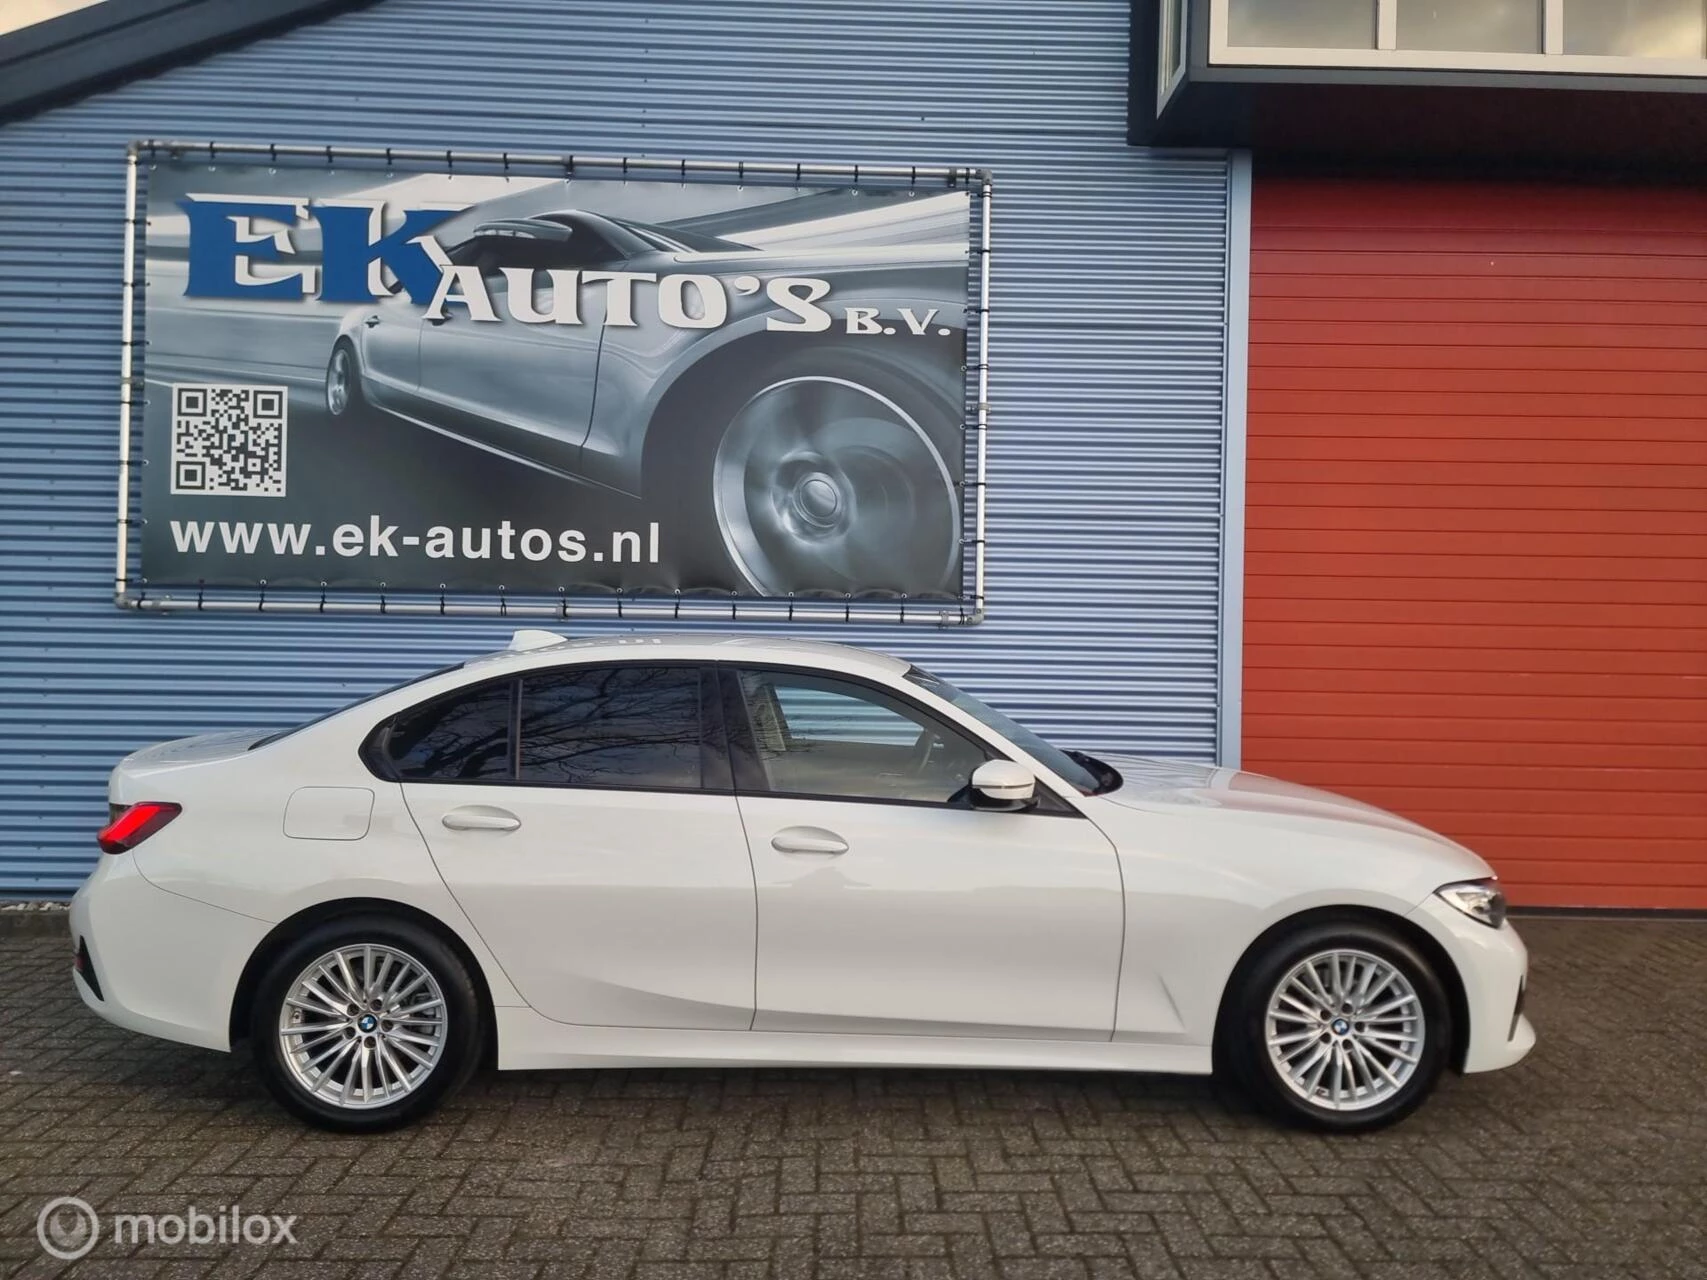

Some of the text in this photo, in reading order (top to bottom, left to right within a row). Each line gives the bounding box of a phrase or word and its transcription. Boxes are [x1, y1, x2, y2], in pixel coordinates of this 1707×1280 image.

[178, 193, 952, 336] EK AUTO'S B.V.
[169, 515, 659, 563] www.ek-autos.nl
